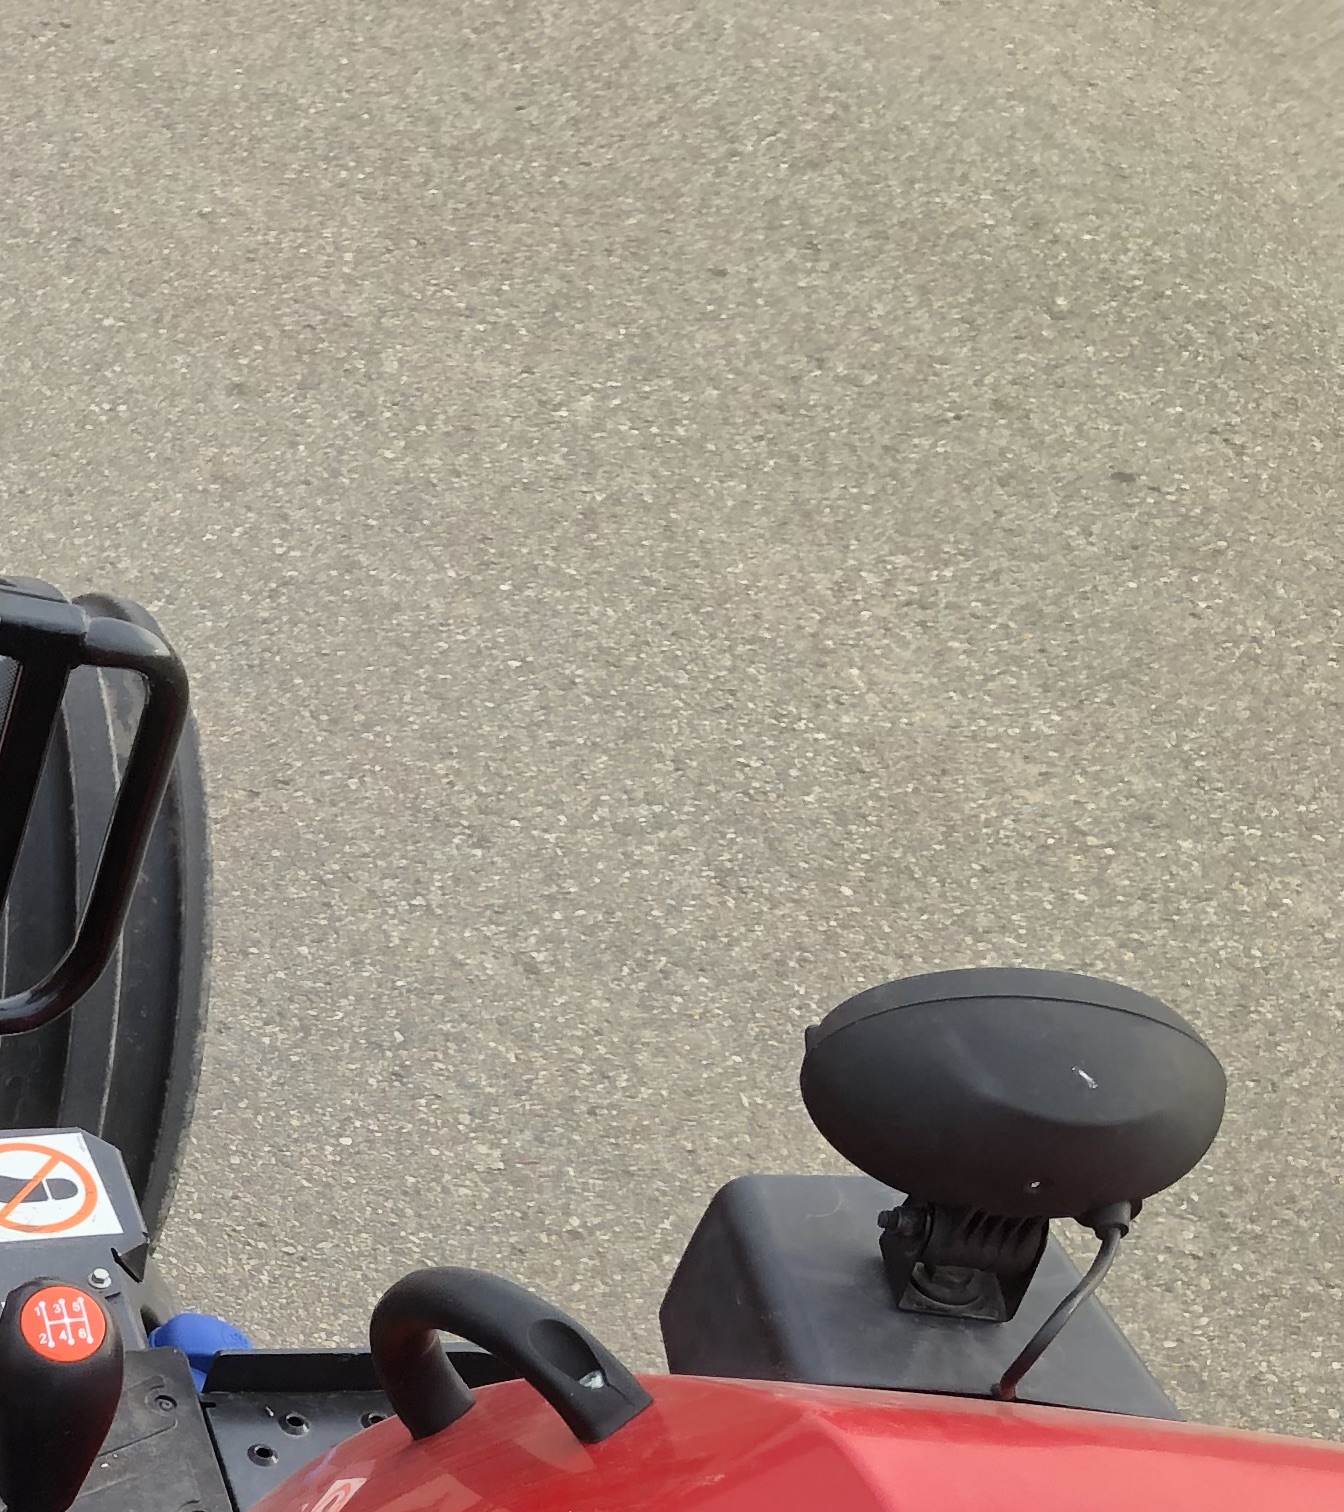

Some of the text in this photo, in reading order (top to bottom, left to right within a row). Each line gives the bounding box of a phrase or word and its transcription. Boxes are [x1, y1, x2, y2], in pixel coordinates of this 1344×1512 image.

[34, 1301, 81, 1317] 1 3 5
[38, 1328, 87, 1345] 2 4 6
